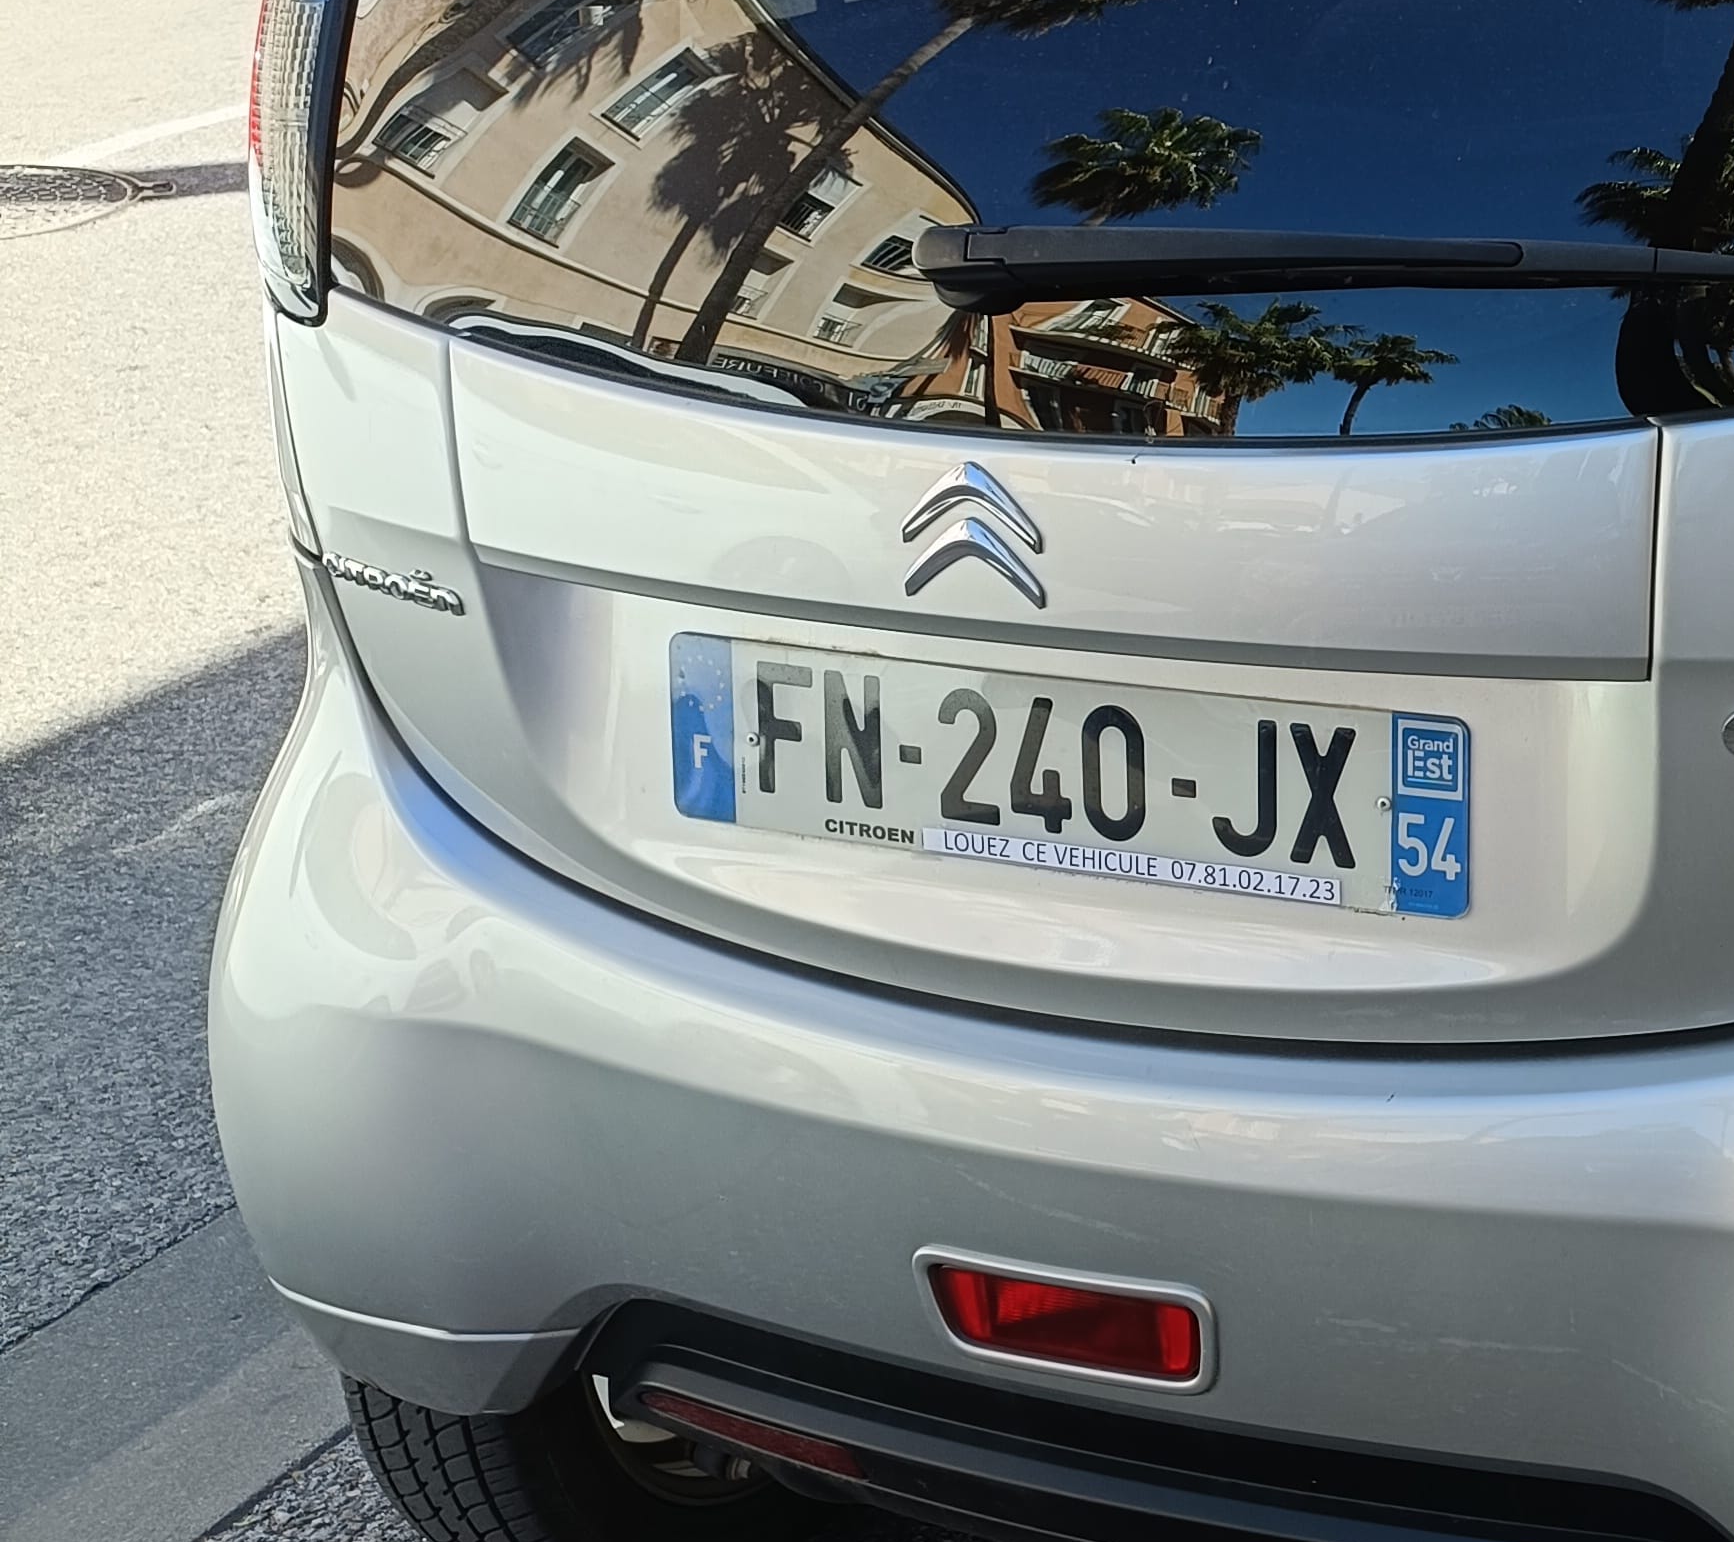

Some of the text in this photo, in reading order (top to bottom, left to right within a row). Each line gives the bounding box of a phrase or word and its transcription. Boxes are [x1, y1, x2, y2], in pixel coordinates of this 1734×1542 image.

[693, 734, 711, 768] F
[1407, 735, 1454, 753] Grand
[756, 659, 1357, 869] FN-240-JX
[1407, 749, 1453, 780] Est
[824, 819, 915, 845] CITROEN
[1397, 812, 1462, 881] 54
[943, 830, 1337, 903] LOUEZ CE VEHICULE 07.81.02.17.23
